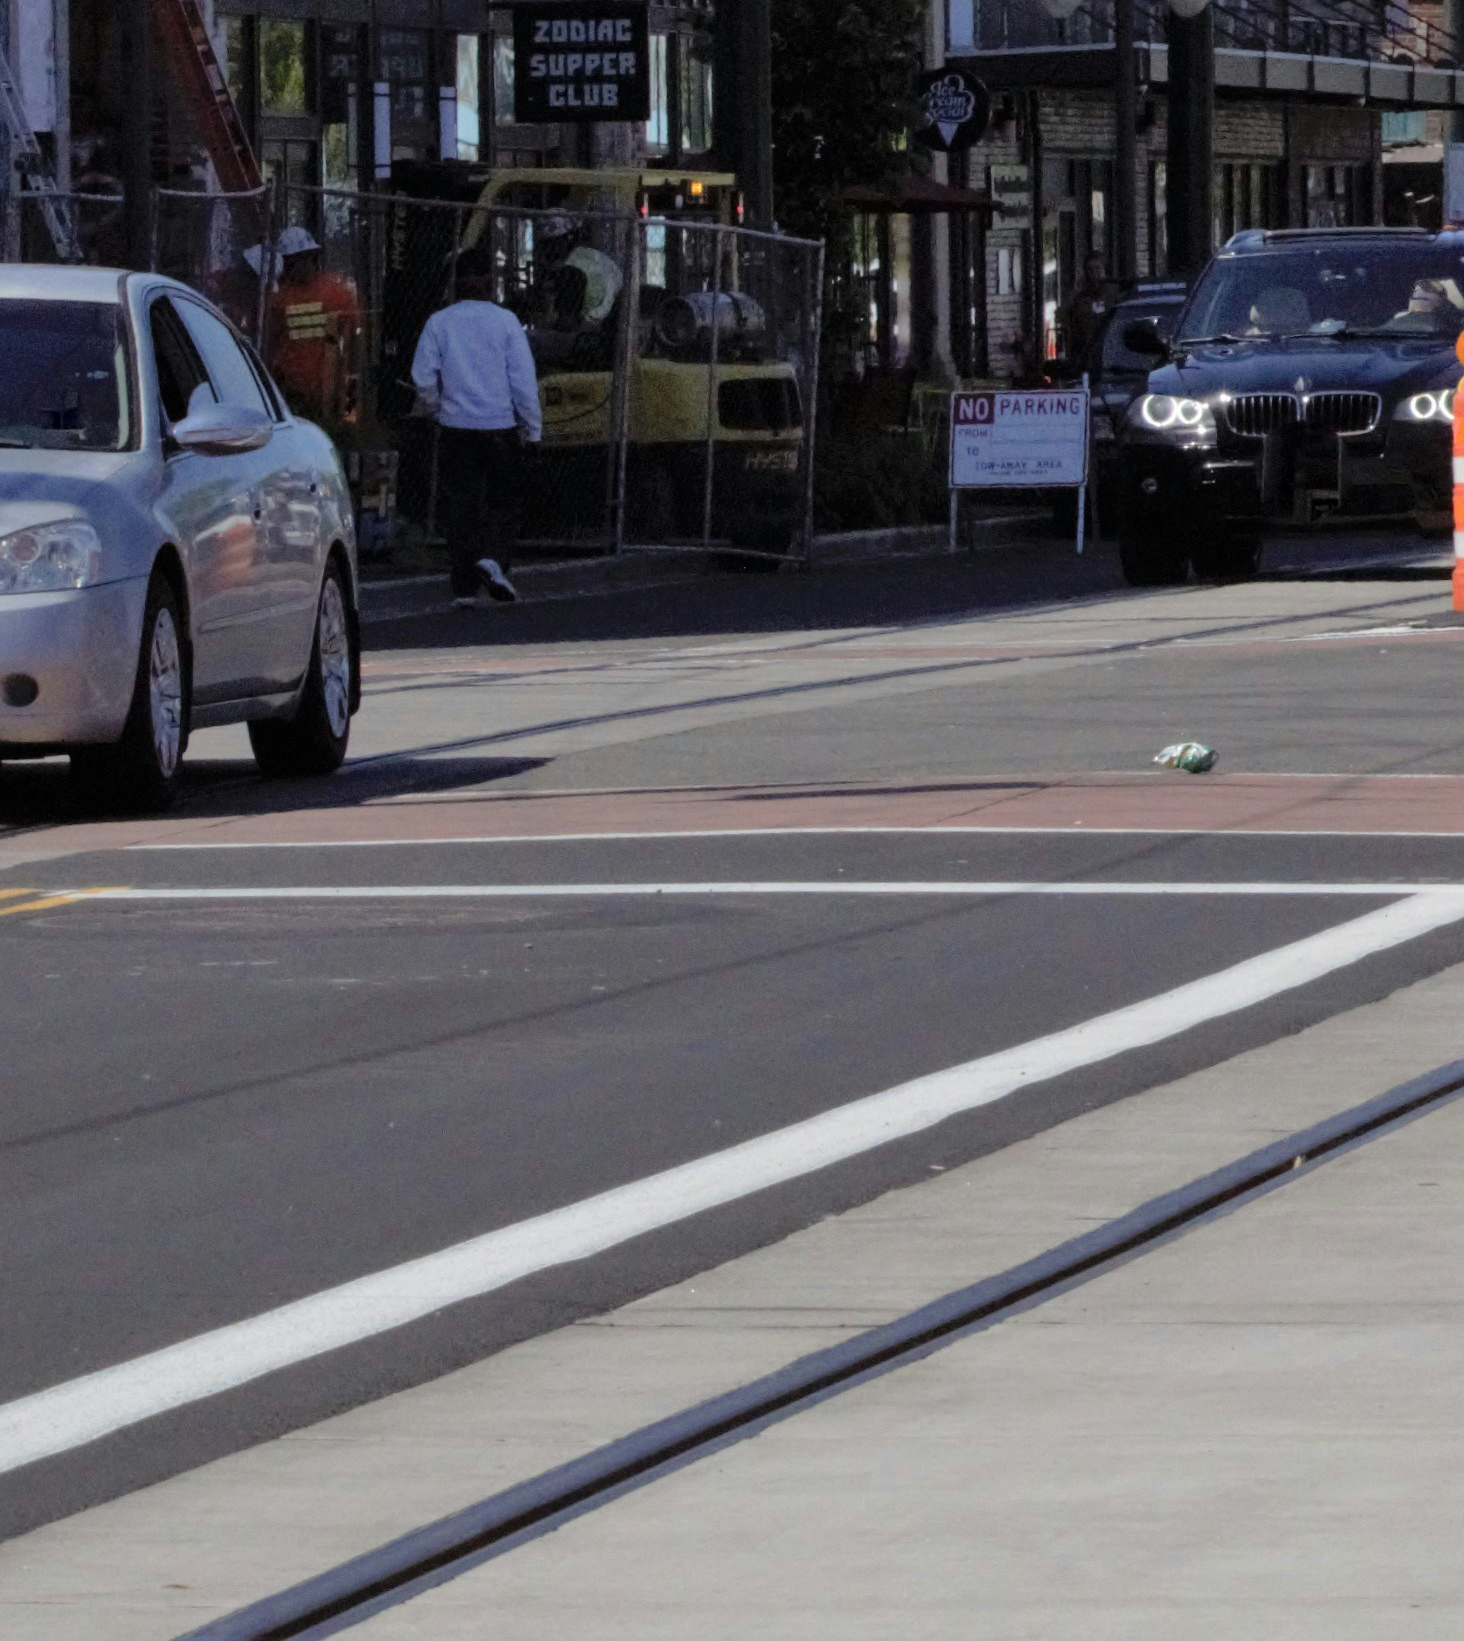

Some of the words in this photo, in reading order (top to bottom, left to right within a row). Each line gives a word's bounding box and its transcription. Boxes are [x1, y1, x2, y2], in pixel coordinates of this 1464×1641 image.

[534, 19, 632, 43] ZODIAC
[530, 51, 637, 77] SUPPER
[549, 83, 619, 107] CLUB
[959, 398, 989, 420] NO
[1000, 398, 1080, 415] PARKING
[958, 428, 988, 438] FROM
[967, 447, 979, 456] TO
